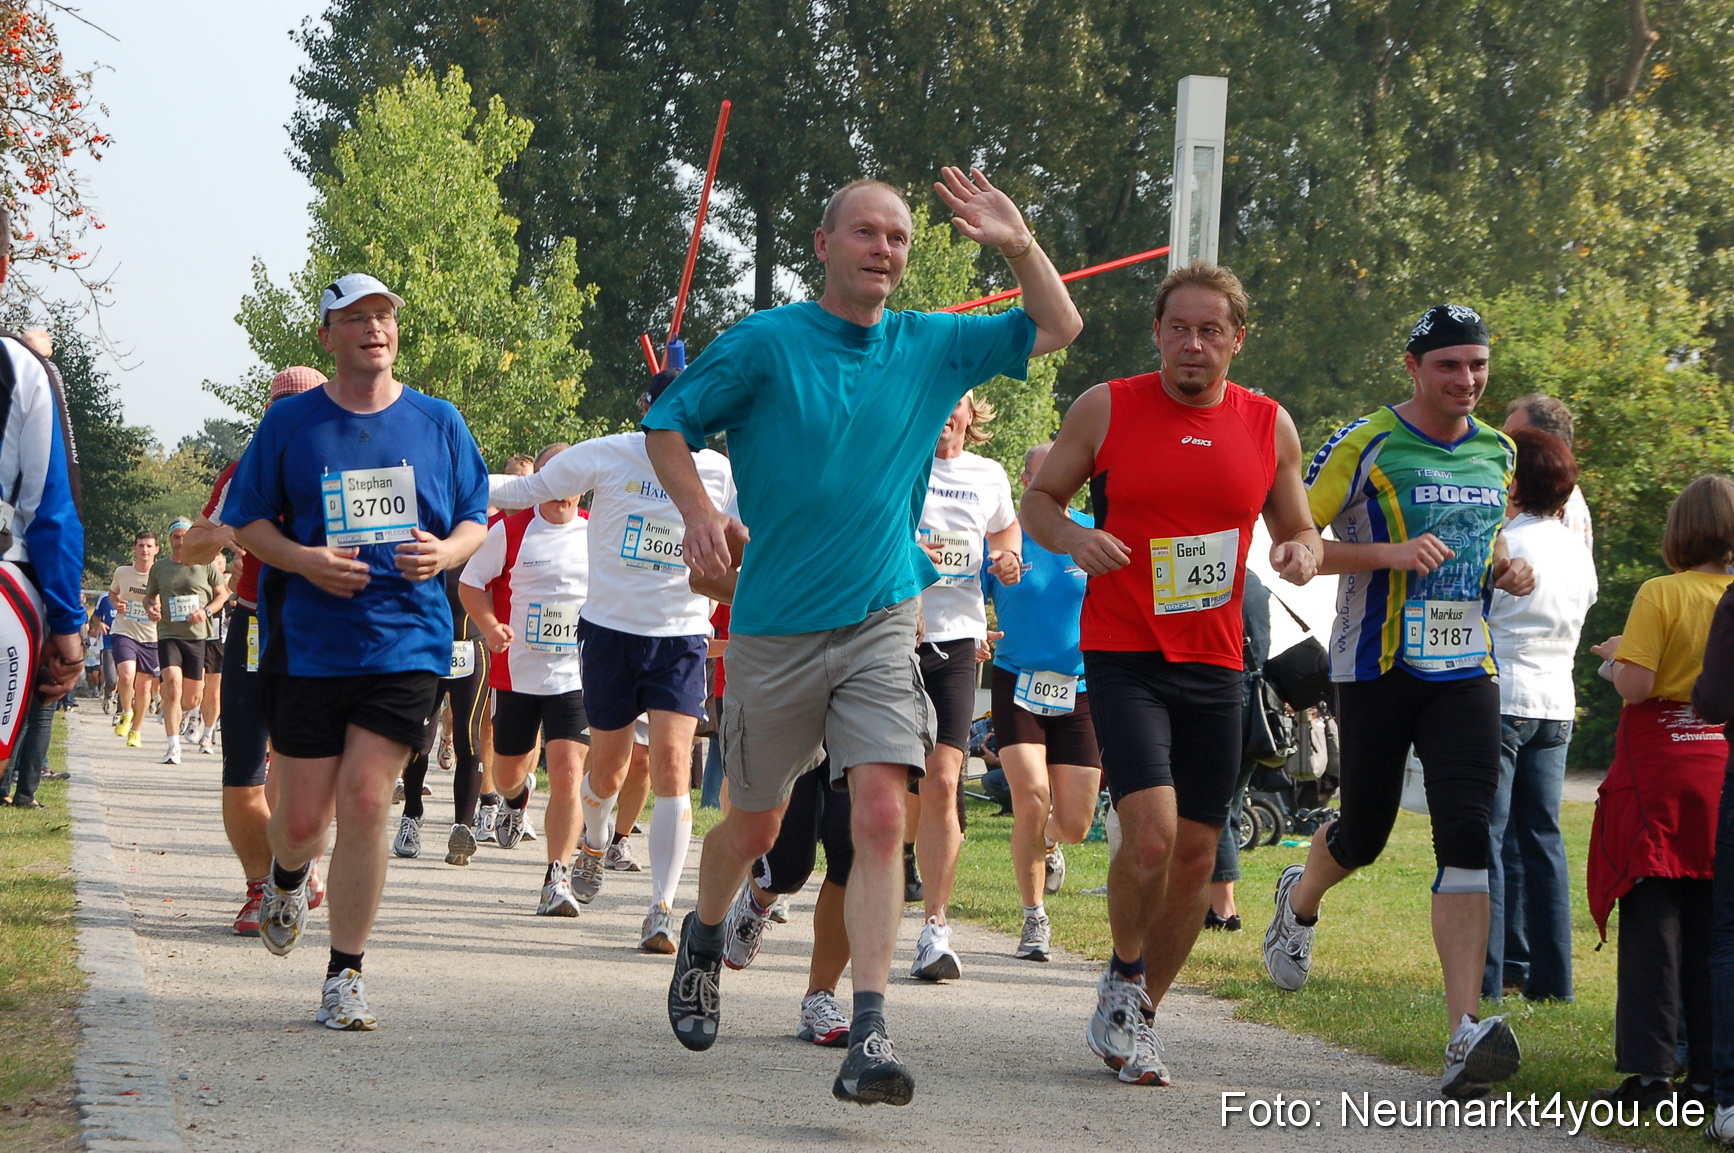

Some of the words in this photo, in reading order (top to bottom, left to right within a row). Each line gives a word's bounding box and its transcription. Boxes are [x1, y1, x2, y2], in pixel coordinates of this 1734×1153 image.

[1191, 438, 1212, 446] asics
[1303, 418, 1370, 490] BOCK
[1414, 468, 1453, 479] TEAM
[348, 476, 393, 493] Stephan
[1412, 483, 1501, 507] BOCK
[352, 496, 406, 518] 3700
[645, 522, 671, 536] Armin
[643, 538, 683, 557] 3605
[933, 535, 970, 547] Hermann
[1176, 541, 1206, 558] Gerd
[1156, 567, 1162, 578] C
[1187, 561, 1227, 586] 433
[544, 608, 562, 619] Jens
[1430, 607, 1464, 620] Markus
[542, 623, 578, 637] 2017
[1411, 626, 1417, 637] C
[1429, 628, 1473, 646] 3187
[451, 656, 466, 667] 83
[1034, 682, 1069, 700] 6032
